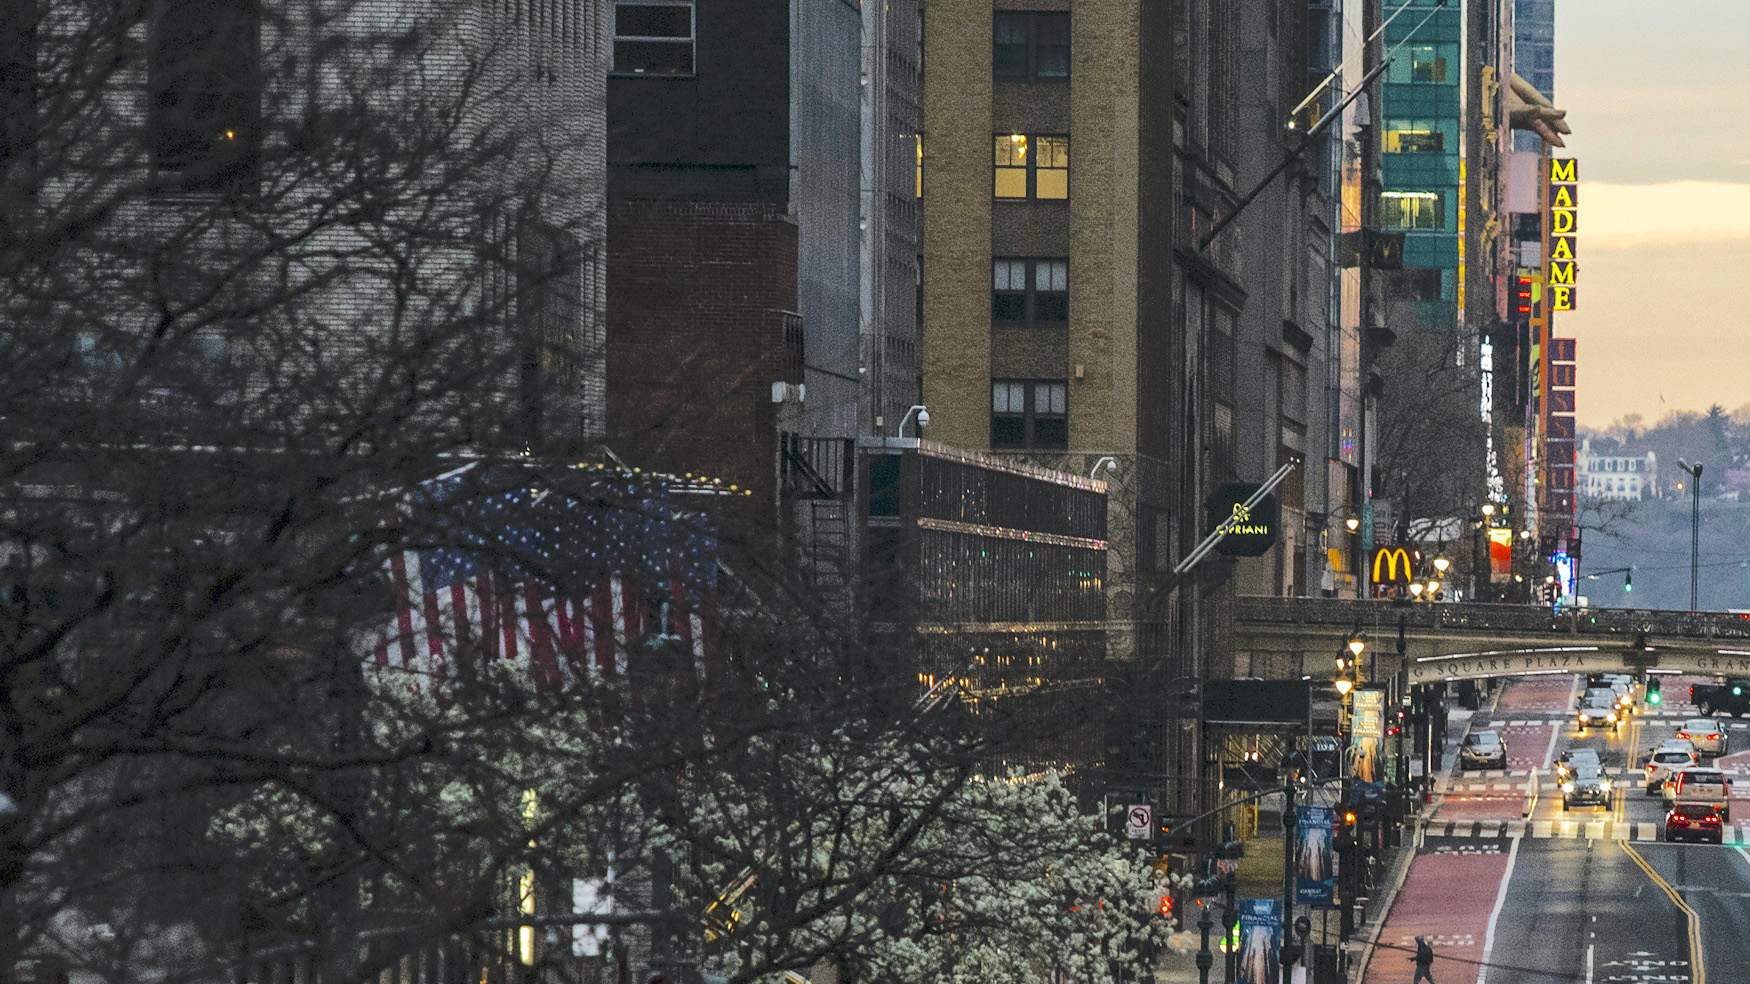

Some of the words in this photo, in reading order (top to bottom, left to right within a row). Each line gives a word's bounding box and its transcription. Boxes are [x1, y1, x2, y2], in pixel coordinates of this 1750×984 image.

[1550, 158, 1577, 311] MADAME
[1437, 657, 1511, 677] SQUARE
[1525, 656, 1585, 668] PLAZA
